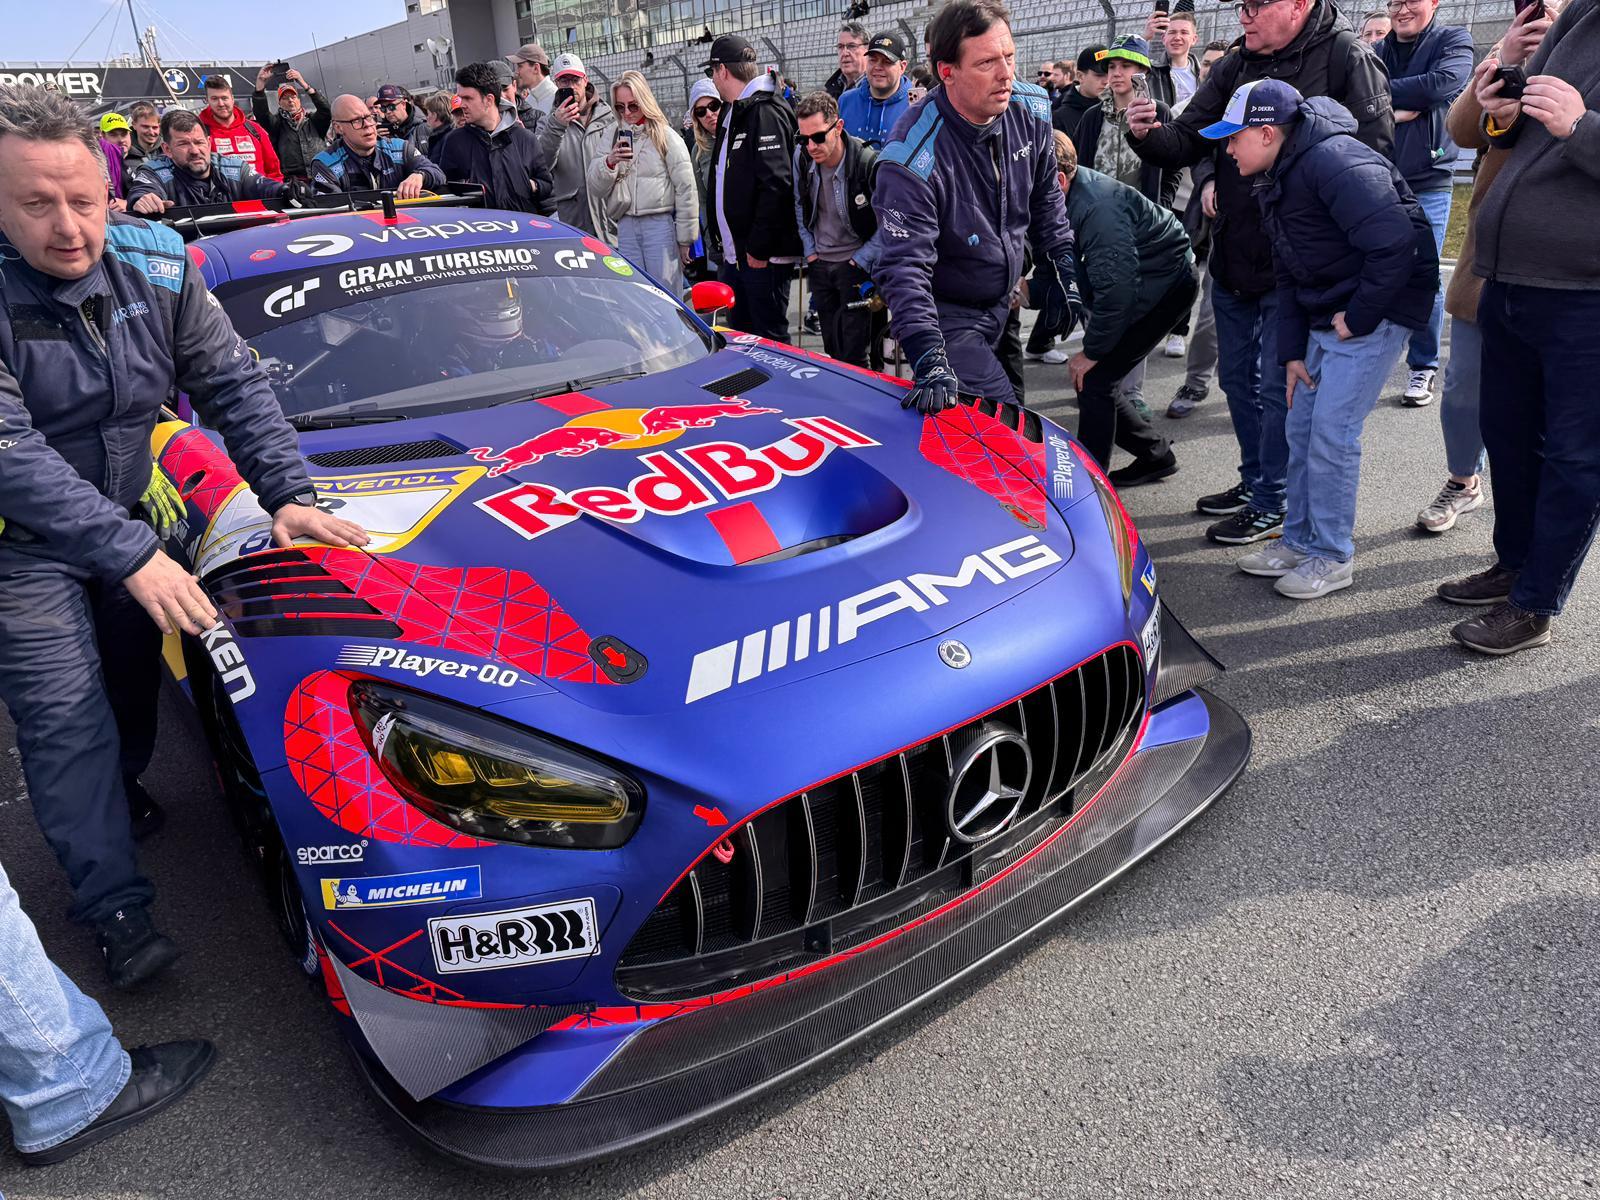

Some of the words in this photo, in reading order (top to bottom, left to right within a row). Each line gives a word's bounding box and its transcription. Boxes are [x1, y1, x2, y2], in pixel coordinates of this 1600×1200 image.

[360, 220, 519, 243] viaplay
[148, 261, 179, 277] OMP
[339, 258, 414, 289] GRAN
[344, 284, 376, 297] THE
[377, 278, 412, 291] REAL
[413, 269, 467, 283] DRIVING
[469, 264, 539, 276] SIMULATOR
[1053, 447, 1075, 484] Player
[314, 475, 444, 491] AVENOL
[838, 534, 1063, 645] AMG
[200, 620, 256, 704] KEN
[369, 646, 478, 678] Player
[367, 878, 467, 900] MICHELIN
[438, 921, 535, 962] H&R
